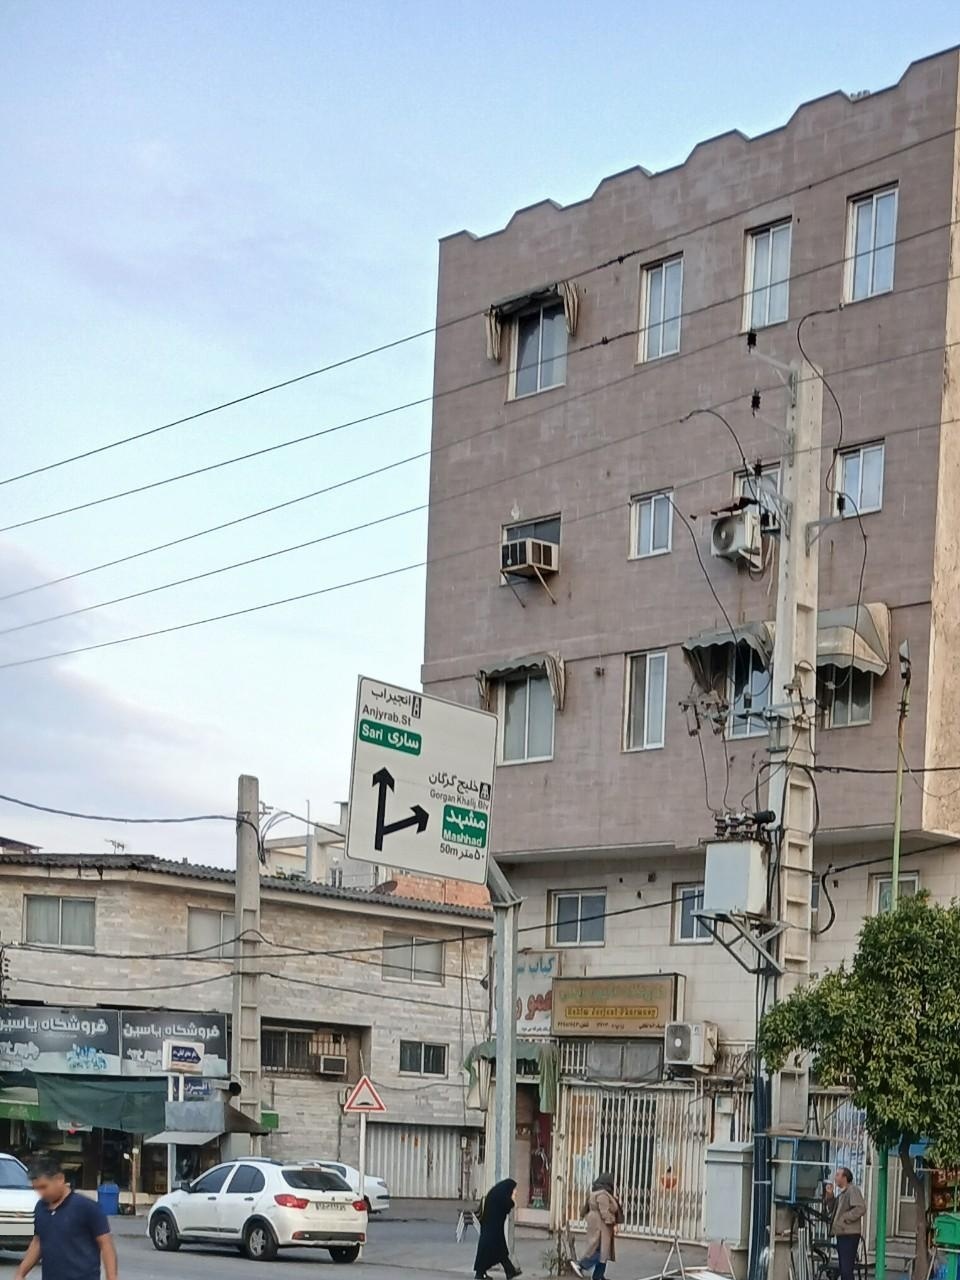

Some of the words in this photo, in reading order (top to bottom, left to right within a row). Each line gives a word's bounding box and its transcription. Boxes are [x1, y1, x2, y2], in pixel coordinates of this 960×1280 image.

[361, 724, 383, 741] Sari
[387, 731, 419, 749] ساری
[456, 777, 479, 795] خلیج
[429, 789, 456, 803] Gorgan
[445, 810, 486, 831] مشهد
[443, 829, 483, 847] Mashhad
[439, 845, 458, 857] 50m
[41, 1014, 109, 1035] فروشگاه
[123, 1023, 161, 1038] یاسین
[165, 1022, 220, 1039] فروشگاه
